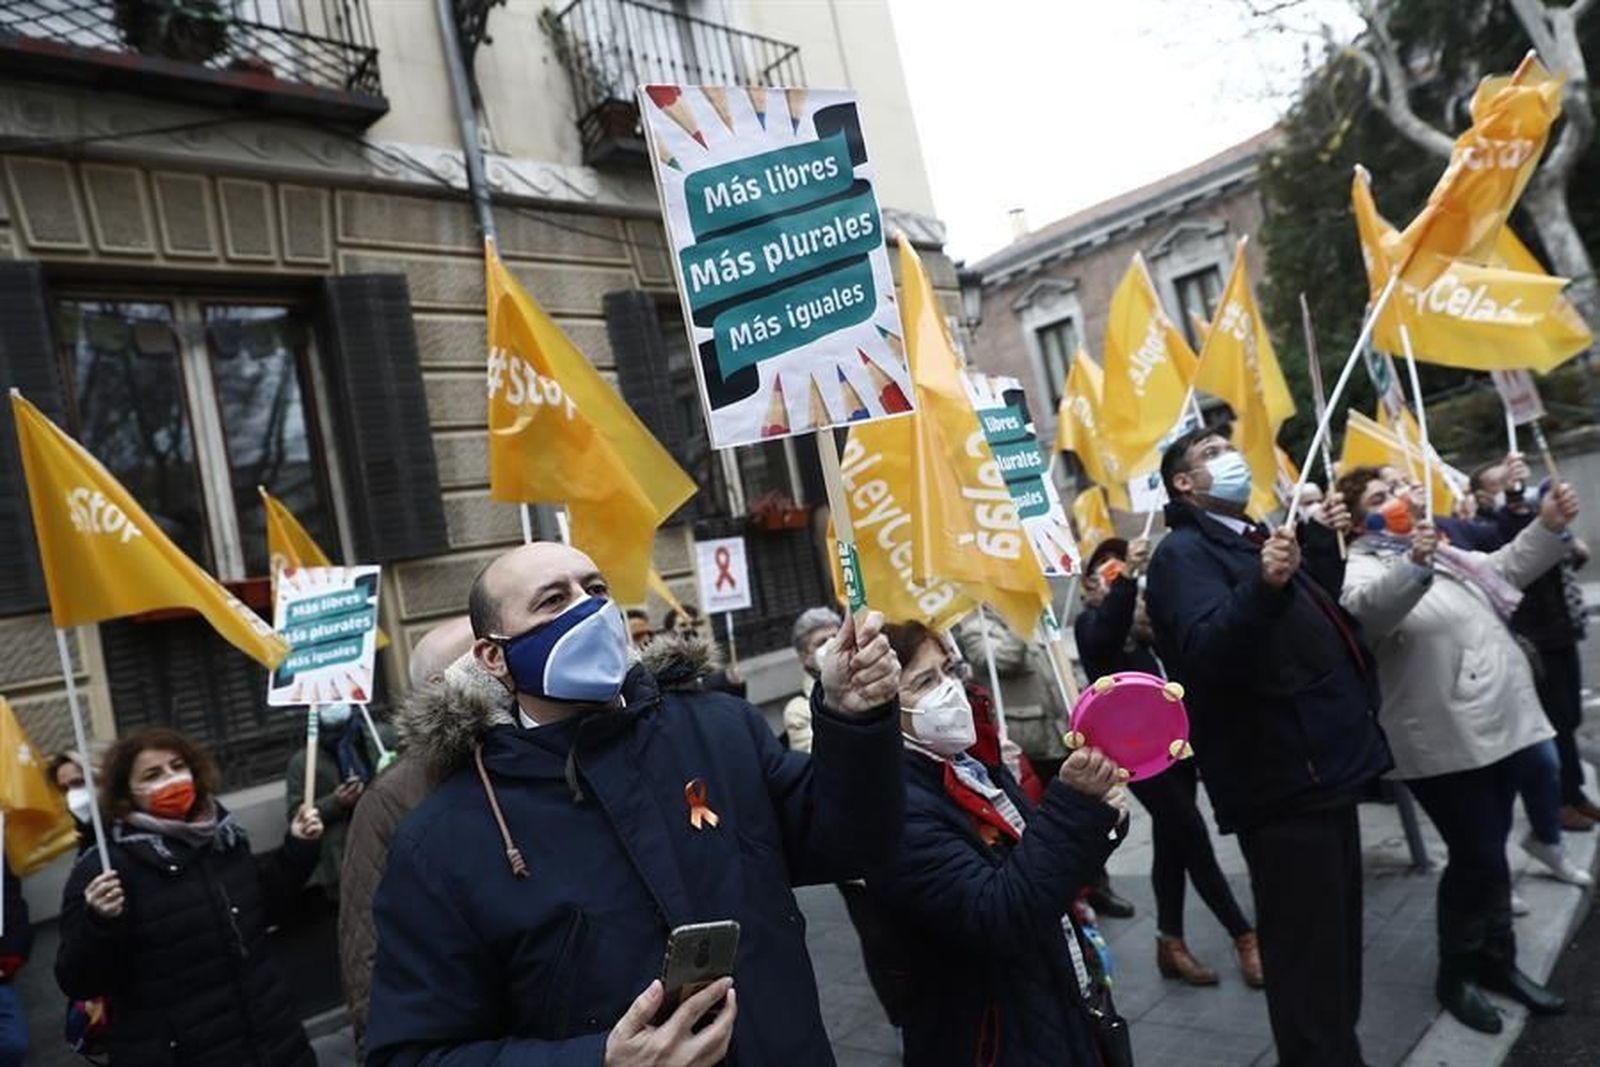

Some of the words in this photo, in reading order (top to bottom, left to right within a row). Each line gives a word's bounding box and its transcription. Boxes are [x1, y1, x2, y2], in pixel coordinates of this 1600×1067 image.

[704, 178, 762, 213] Más
[766, 155, 839, 196] libres
[690, 248, 756, 293] Más
[763, 212, 874, 273] plurales
[730, 314, 782, 351] Más
[788, 283, 865, 328] iguales
[996, 450, 1041, 471] lurales
